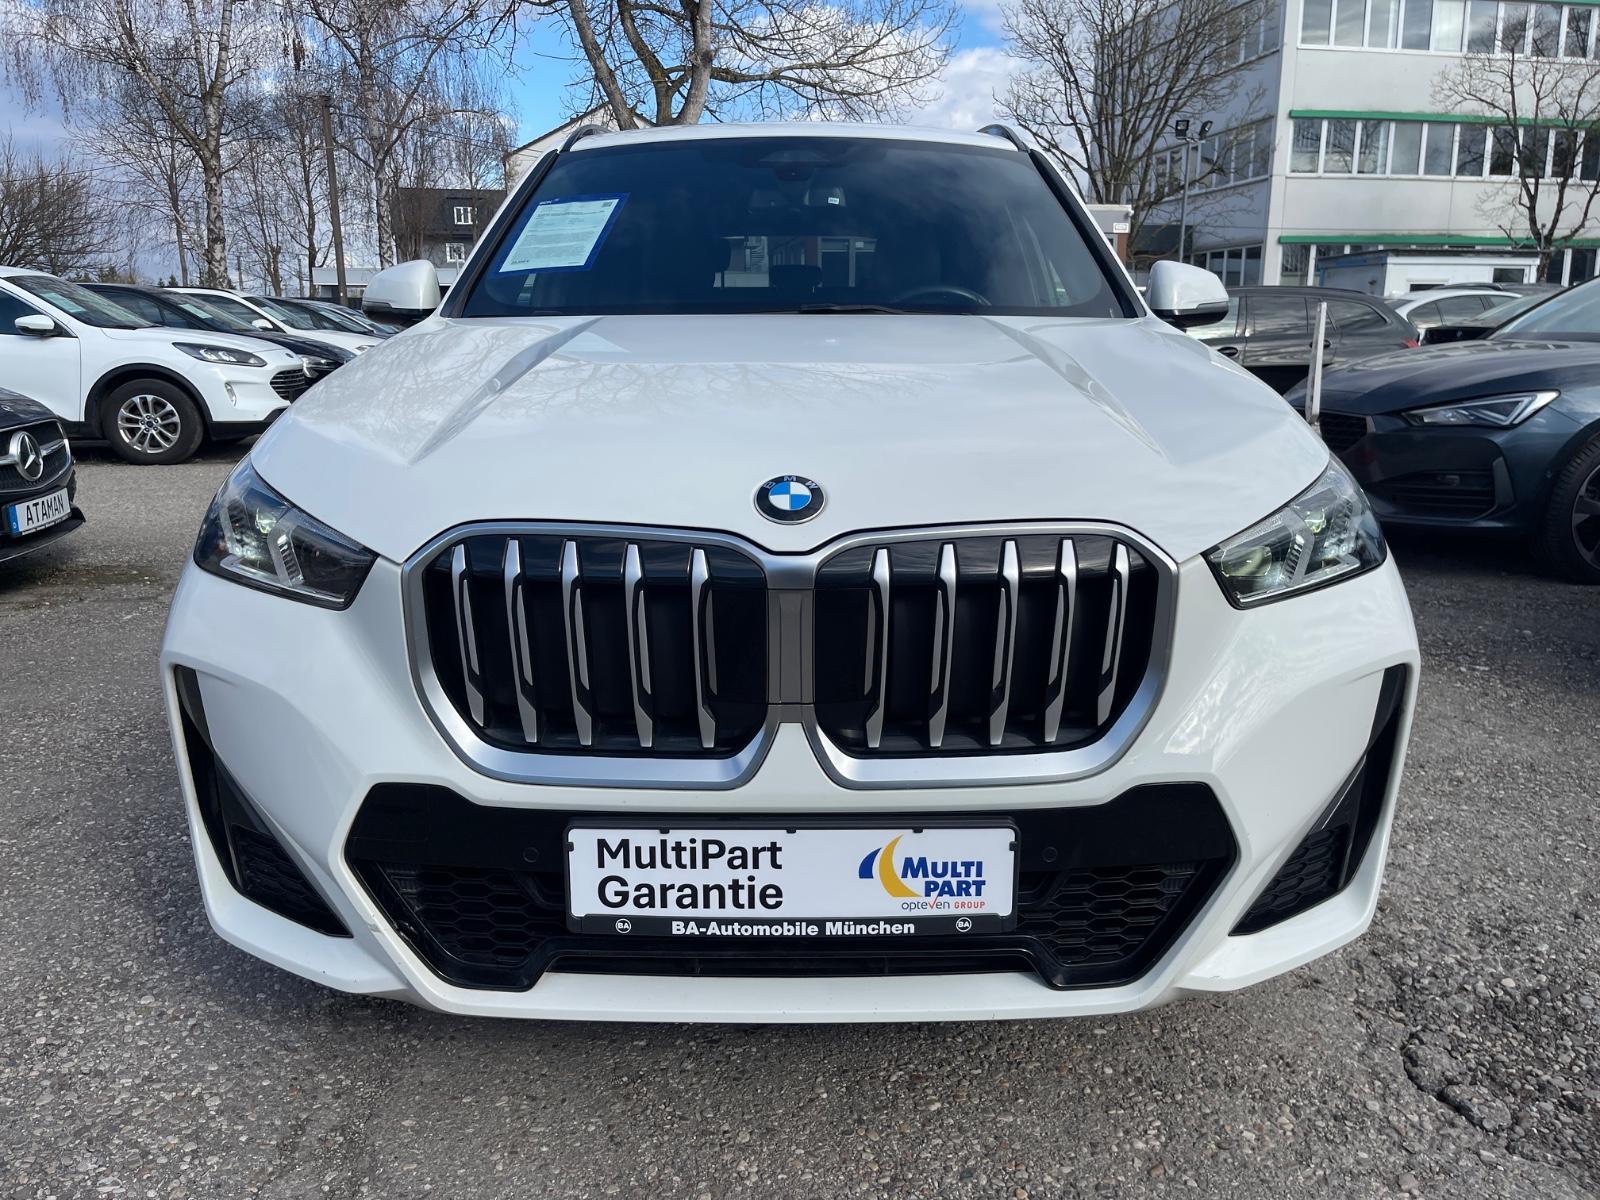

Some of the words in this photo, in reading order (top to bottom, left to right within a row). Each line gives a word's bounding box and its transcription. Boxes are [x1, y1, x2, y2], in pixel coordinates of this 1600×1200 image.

[763, 475, 818, 490] BMW
[26, 494, 65, 526] ATAMAN
[596, 837, 783, 870] MultiPart
[597, 875, 784, 910] Garantie
[924, 880, 986, 898] PART
[901, 897, 950, 912] opteven
[954, 901, 986, 909] GROUP
[616, 921, 631, 931] BA
[671, 920, 819, 937] BA-Automobile
[825, 919, 915, 936] München
[956, 920, 971, 930] BA
